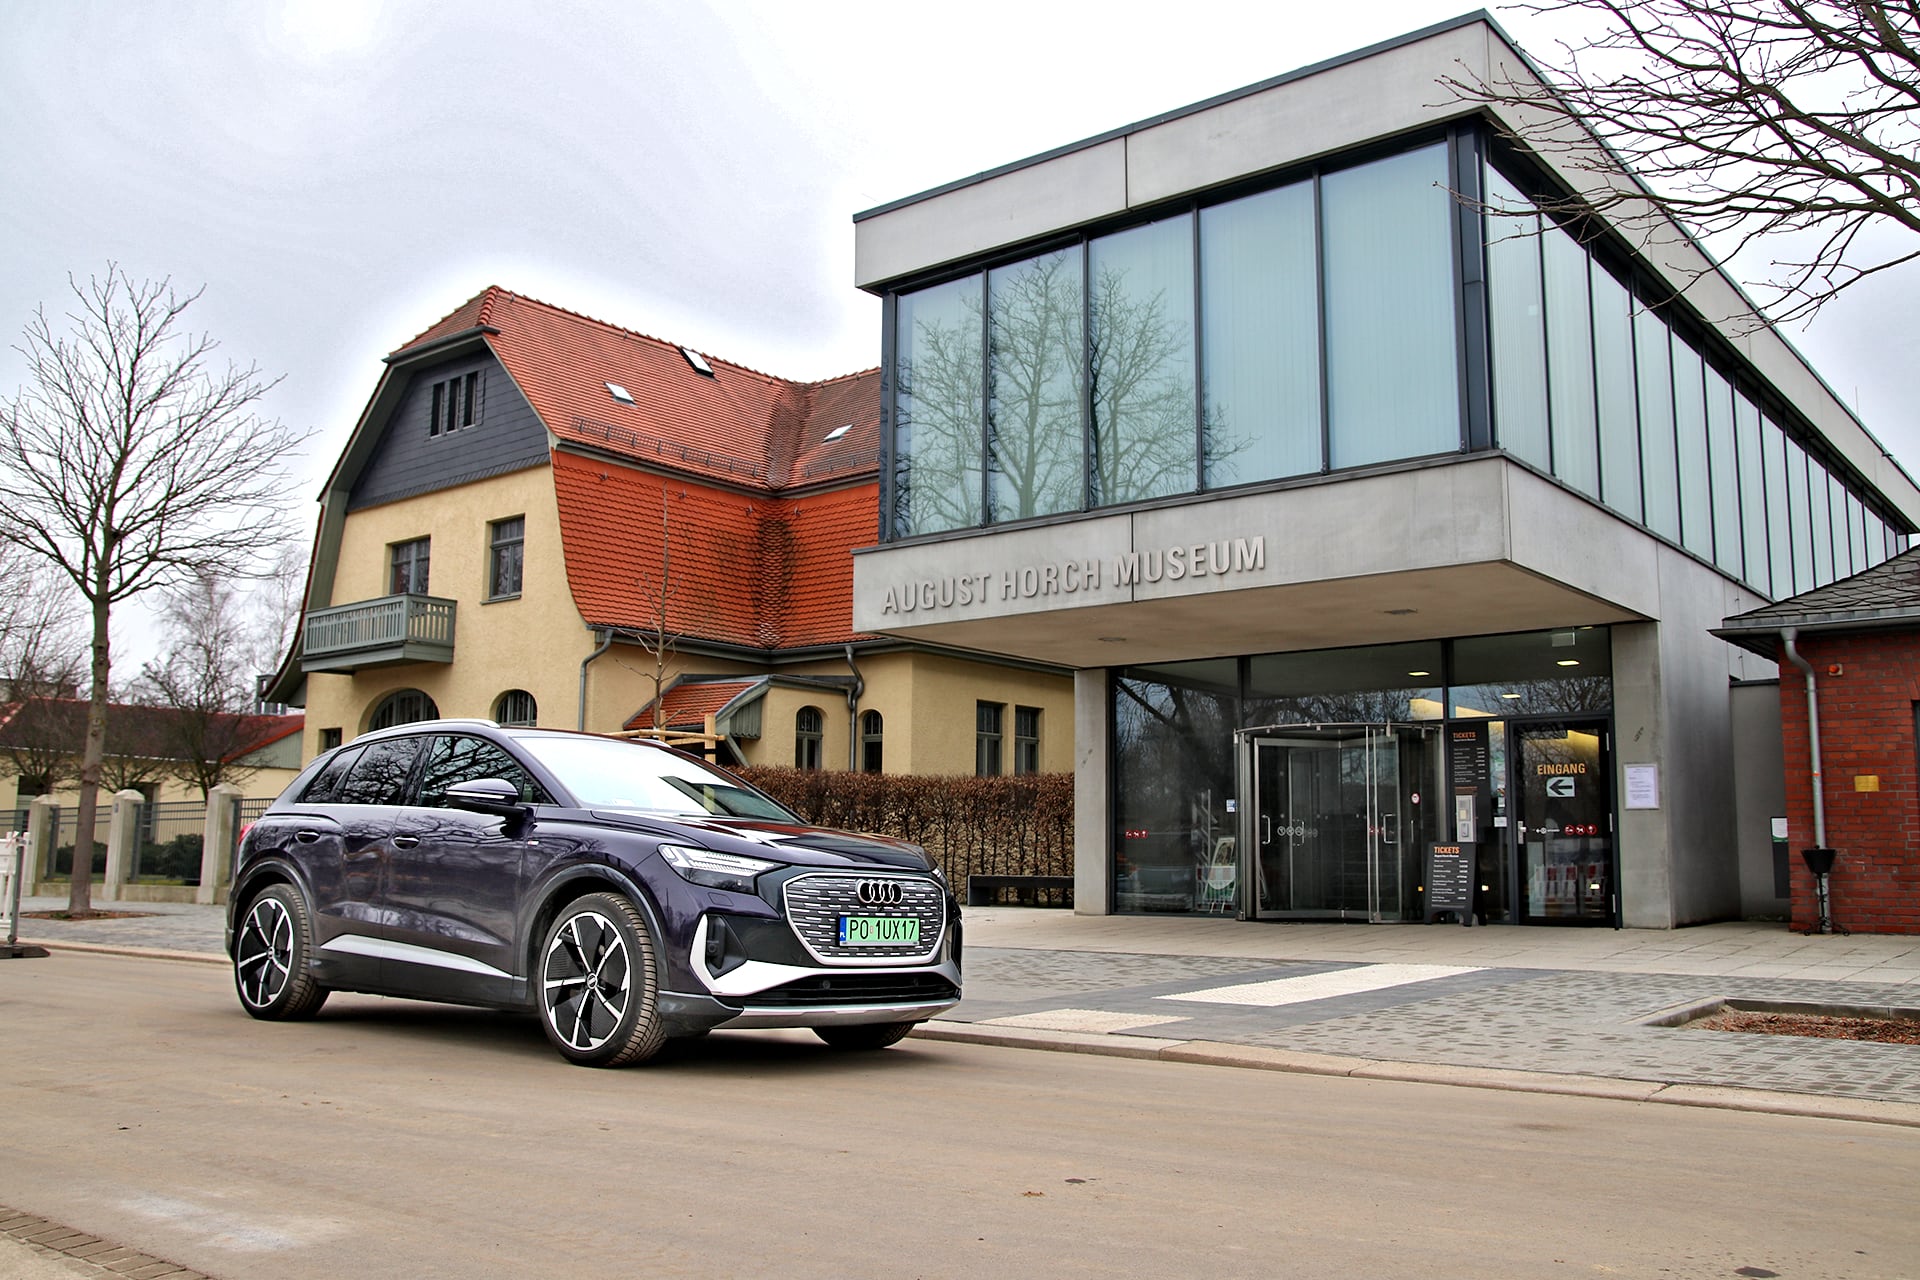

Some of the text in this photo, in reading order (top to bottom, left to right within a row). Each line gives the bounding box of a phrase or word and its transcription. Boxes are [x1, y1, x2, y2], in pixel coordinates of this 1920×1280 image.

[881, 535, 1266, 615] AUGUST HORCH MUSEUM
[1453, 731, 1477, 739] TICKETS
[1537, 763, 1586, 775] EINGANG
[1433, 846, 1460, 854] TICKETS
[849, 919, 916, 940] PO 1UX17
